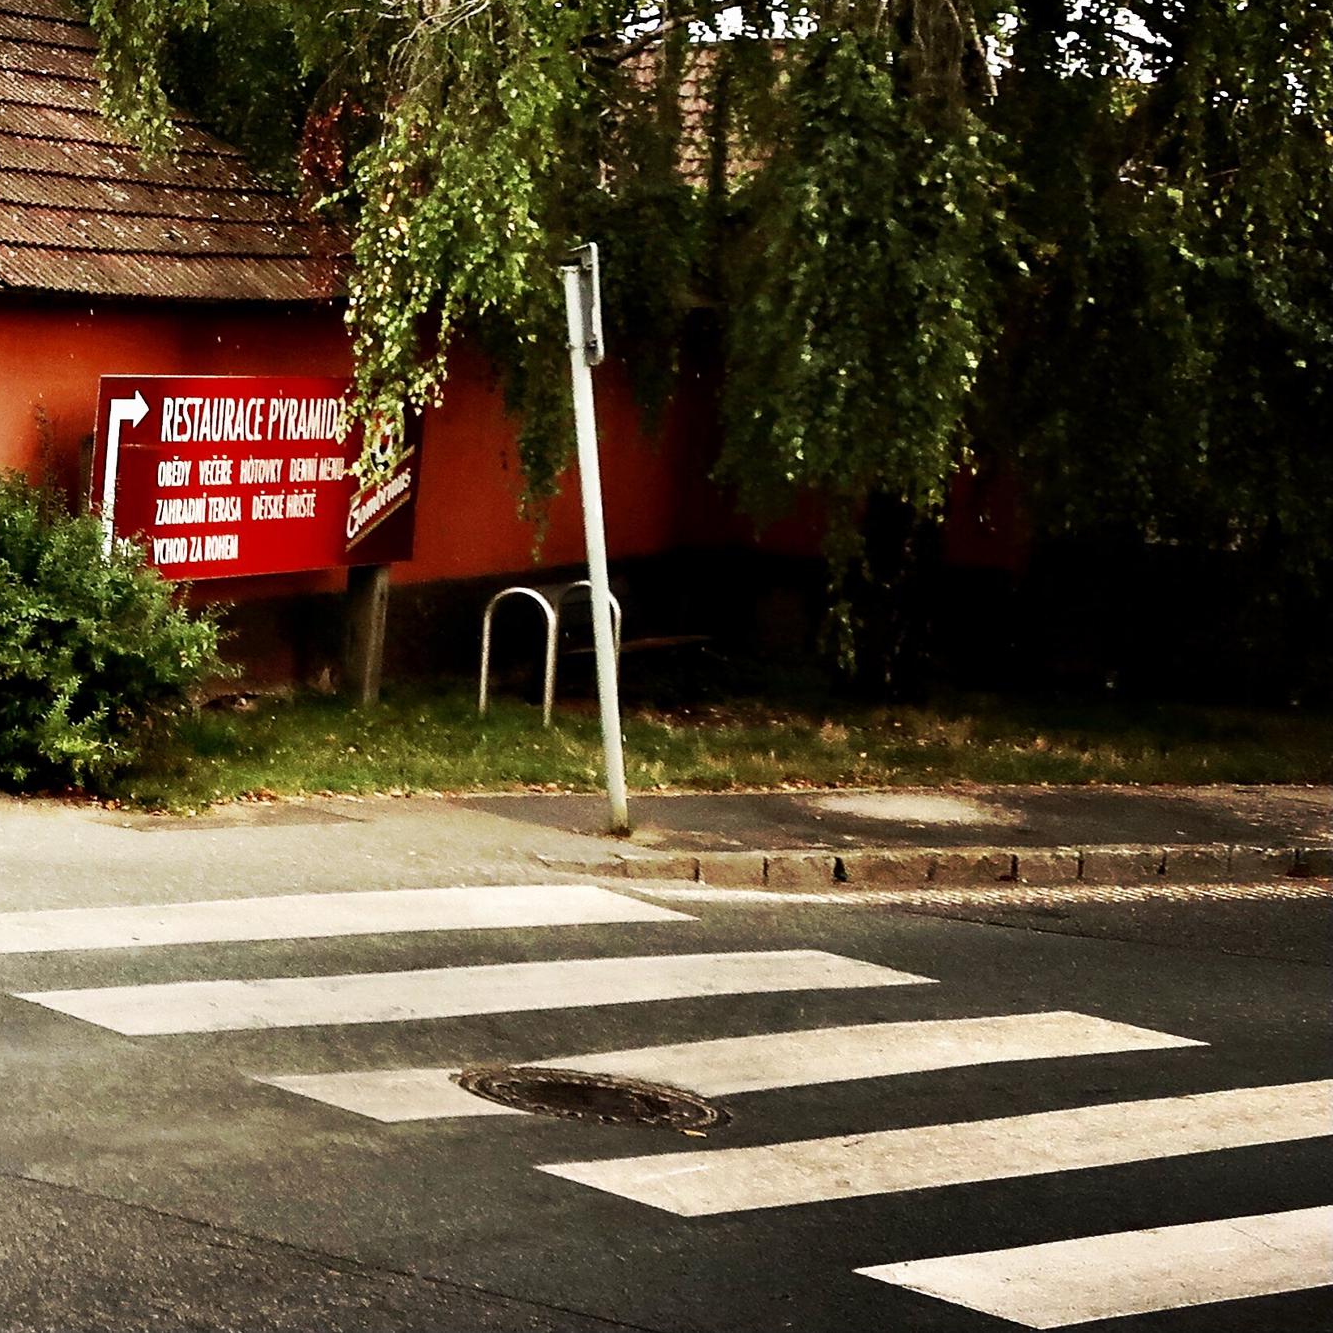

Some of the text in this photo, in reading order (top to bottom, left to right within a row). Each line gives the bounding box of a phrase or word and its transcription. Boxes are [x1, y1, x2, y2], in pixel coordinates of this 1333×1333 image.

[161, 397, 266, 442] RESTAURACE
[157, 455, 192, 487] OBĚDY
[199, 454, 233, 486] VEČEŘE
[239, 458, 284, 485] HOTOVKY
[154, 488, 317, 526] ZAHRADNÍ TERASA DĚTSKÉ HŘIŠTĚ
[153, 536, 188, 566] VCHOD
[189, 536, 203, 563] ZA
[203, 534, 239, 562] ROHEM
